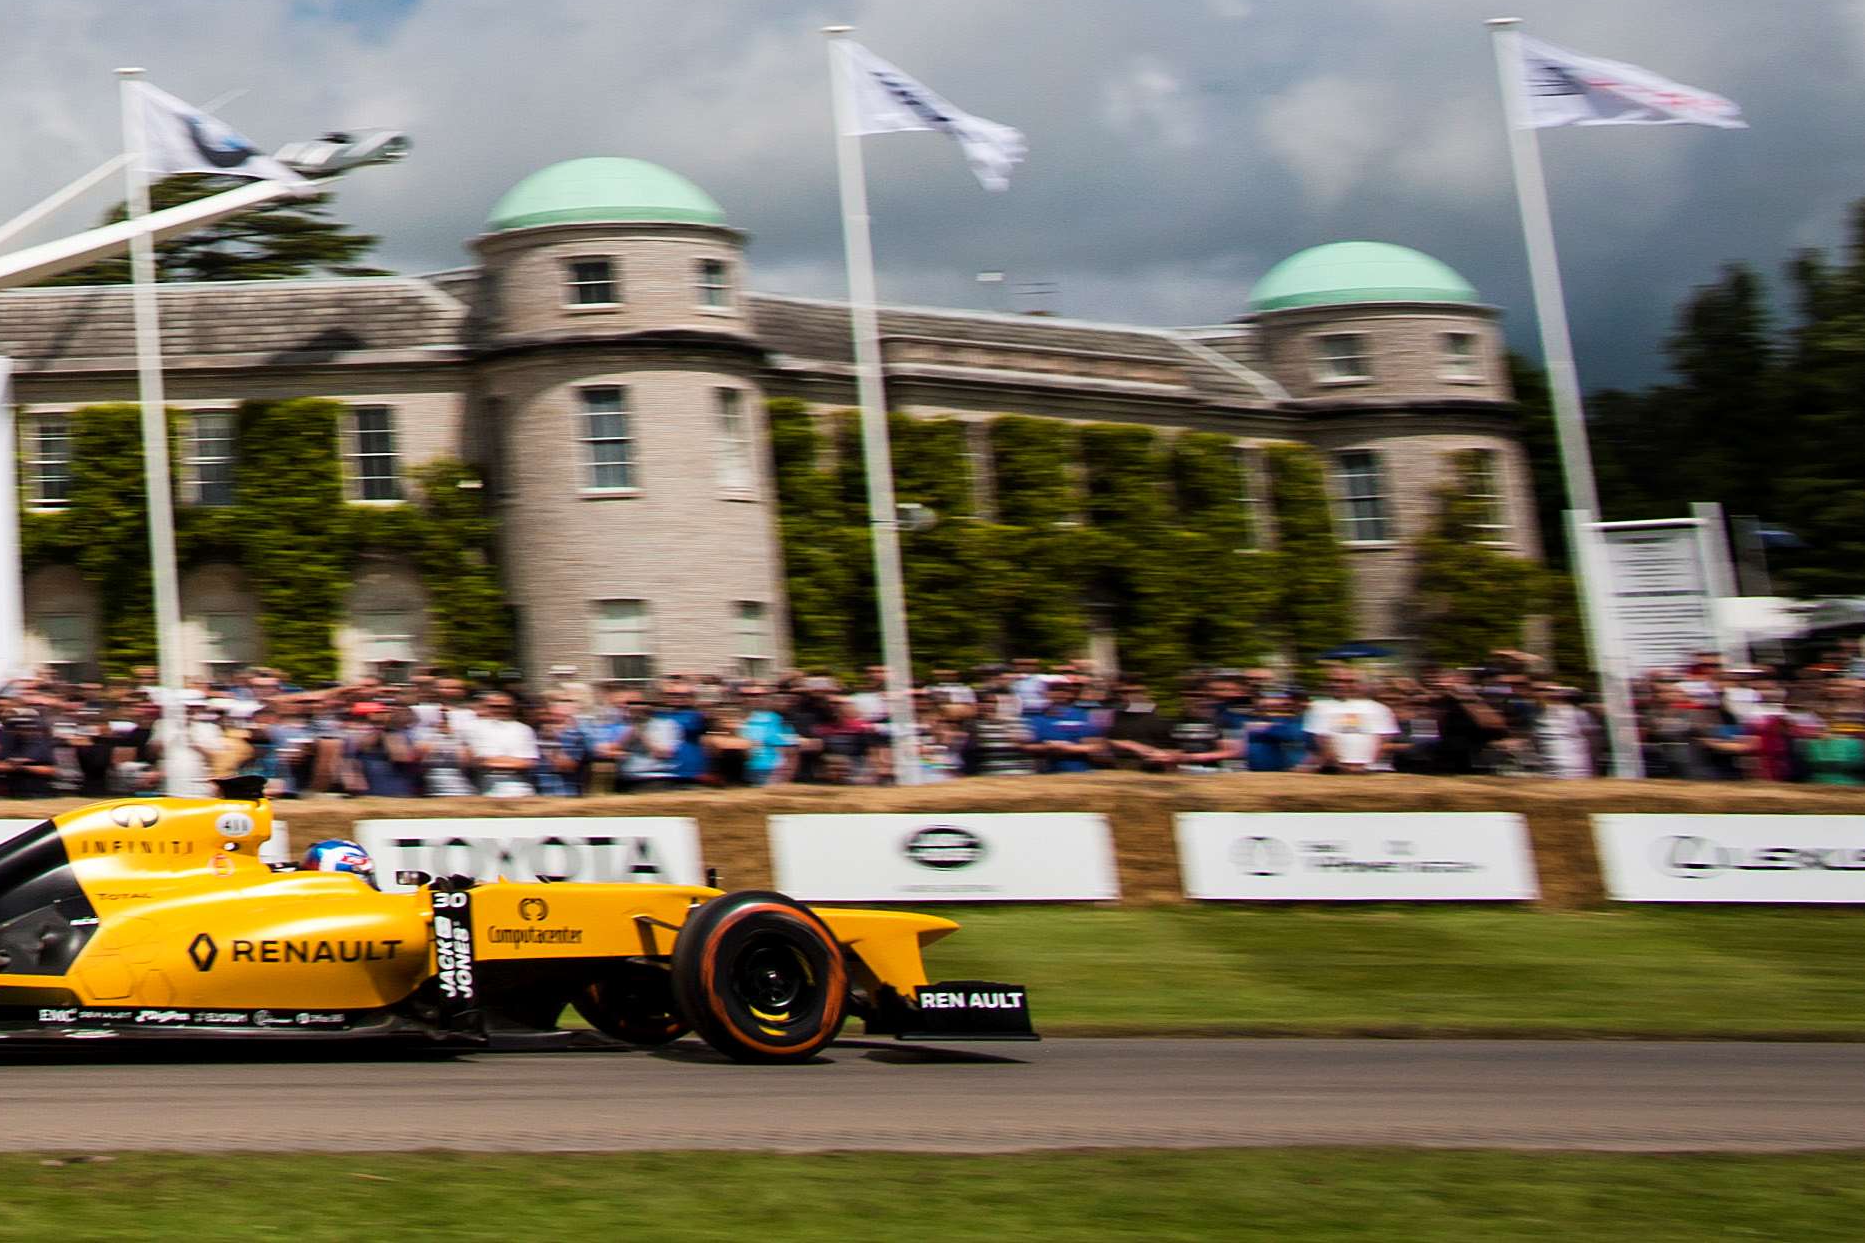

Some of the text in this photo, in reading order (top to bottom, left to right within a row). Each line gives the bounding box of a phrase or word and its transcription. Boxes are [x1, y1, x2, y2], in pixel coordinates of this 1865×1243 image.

[385, 837, 663, 884] TOYOTA
[433, 892, 468, 908] 30
[487, 925, 584, 950] Computacenter
[231, 939, 403, 963] RENAULT
